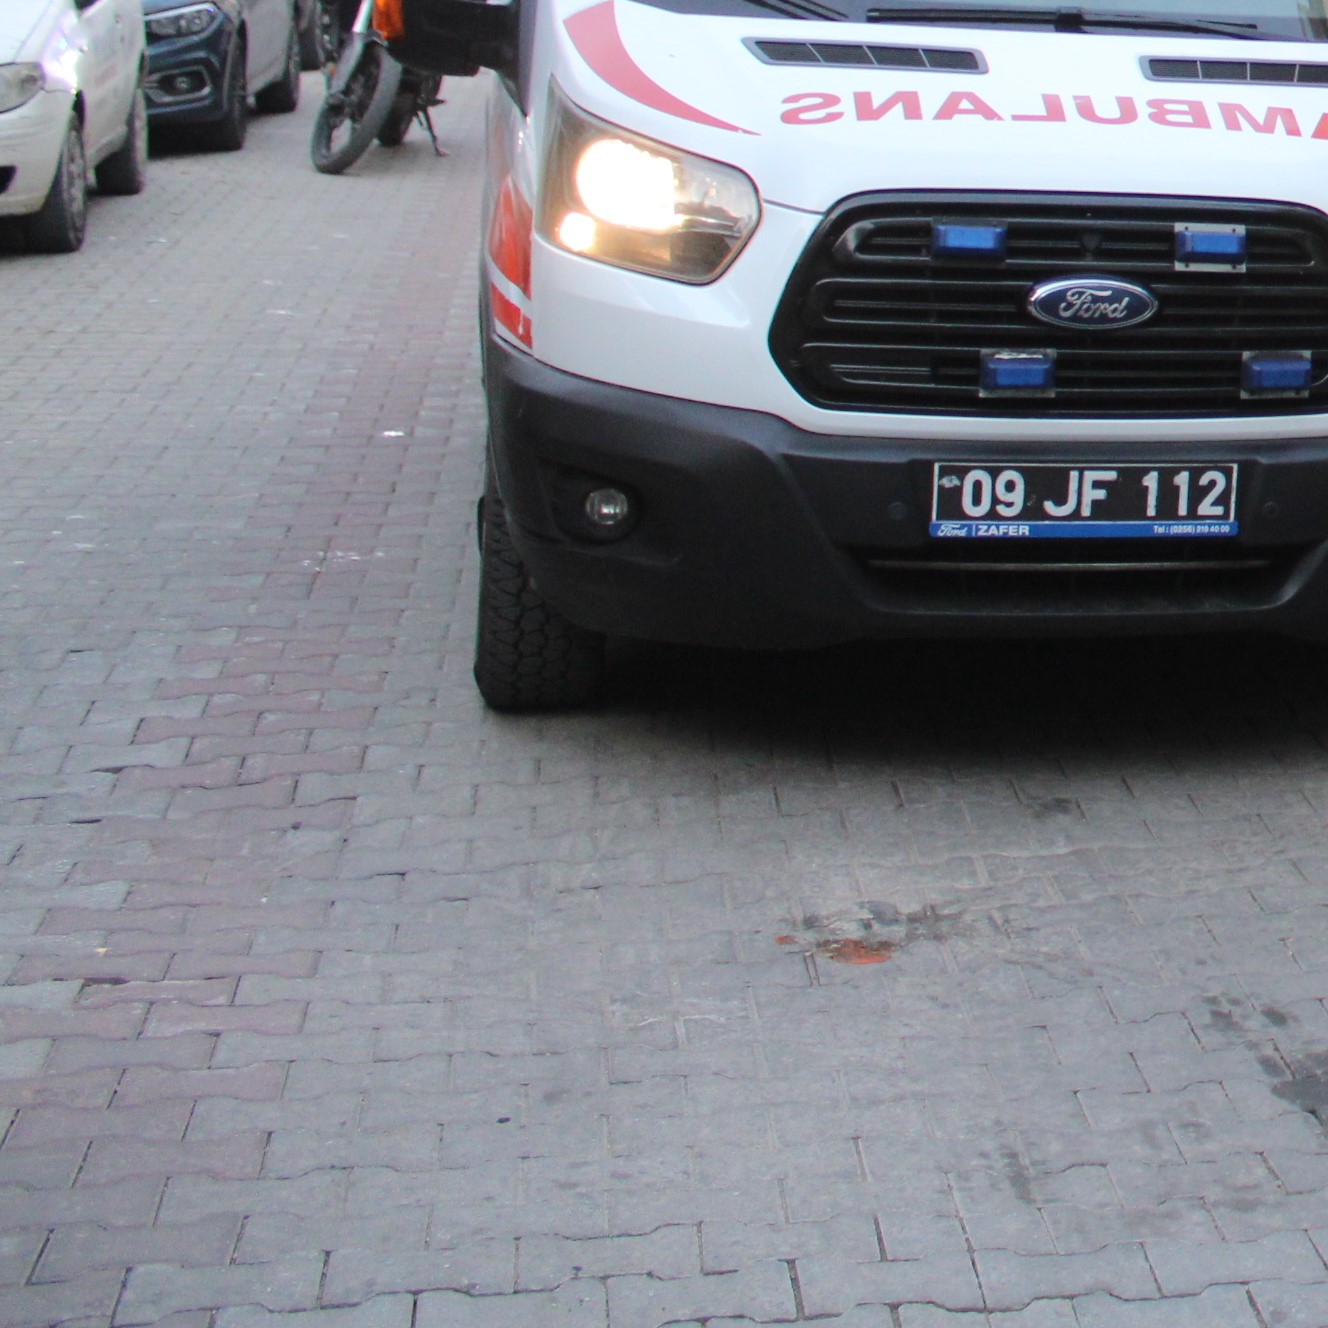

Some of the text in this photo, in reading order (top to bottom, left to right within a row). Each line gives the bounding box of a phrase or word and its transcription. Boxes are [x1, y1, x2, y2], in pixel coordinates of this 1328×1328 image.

[1059, 287, 1129, 319] Ford
[961, 469, 1228, 518] 09 JF 112
[937, 523, 1030, 537] Ford ZAFER
